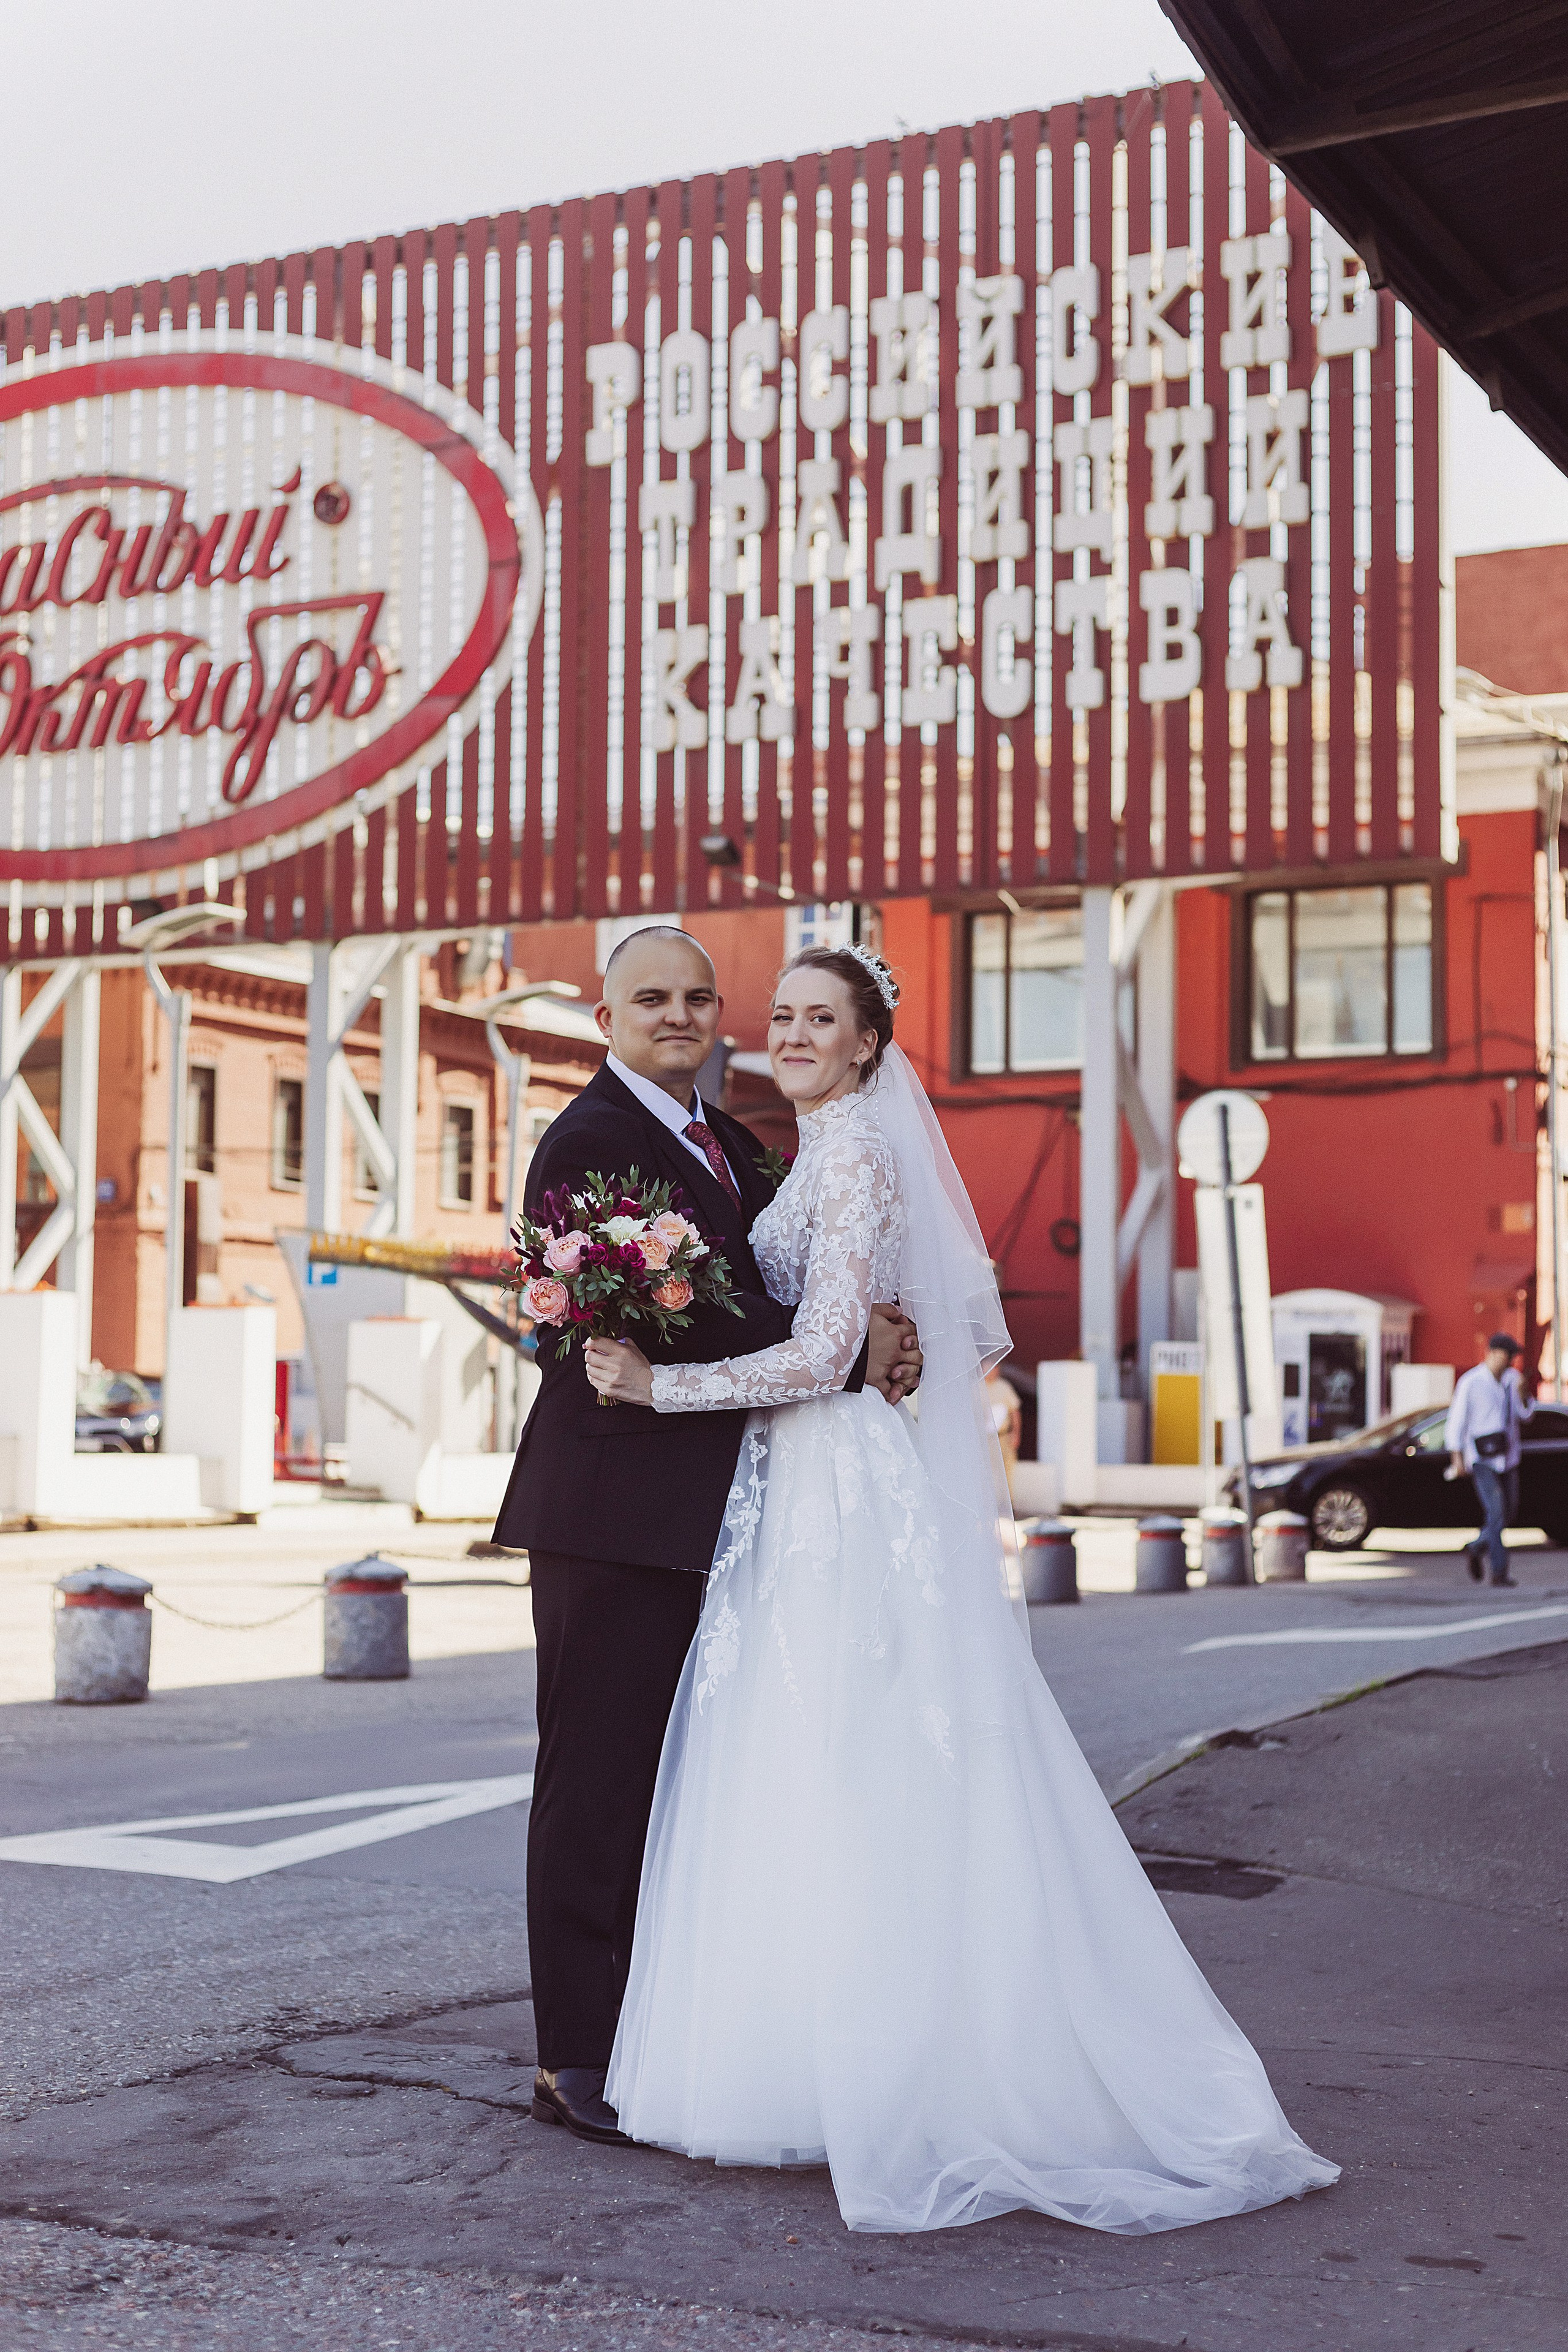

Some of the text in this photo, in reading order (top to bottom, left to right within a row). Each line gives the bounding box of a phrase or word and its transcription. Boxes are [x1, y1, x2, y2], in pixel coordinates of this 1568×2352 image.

[586, 232, 1378, 467] РОССИЙСКИЕ
[639, 390, 1308, 602] ТРАДИЦИИ
[652, 556, 1303, 752] КАЧЕСТВА
